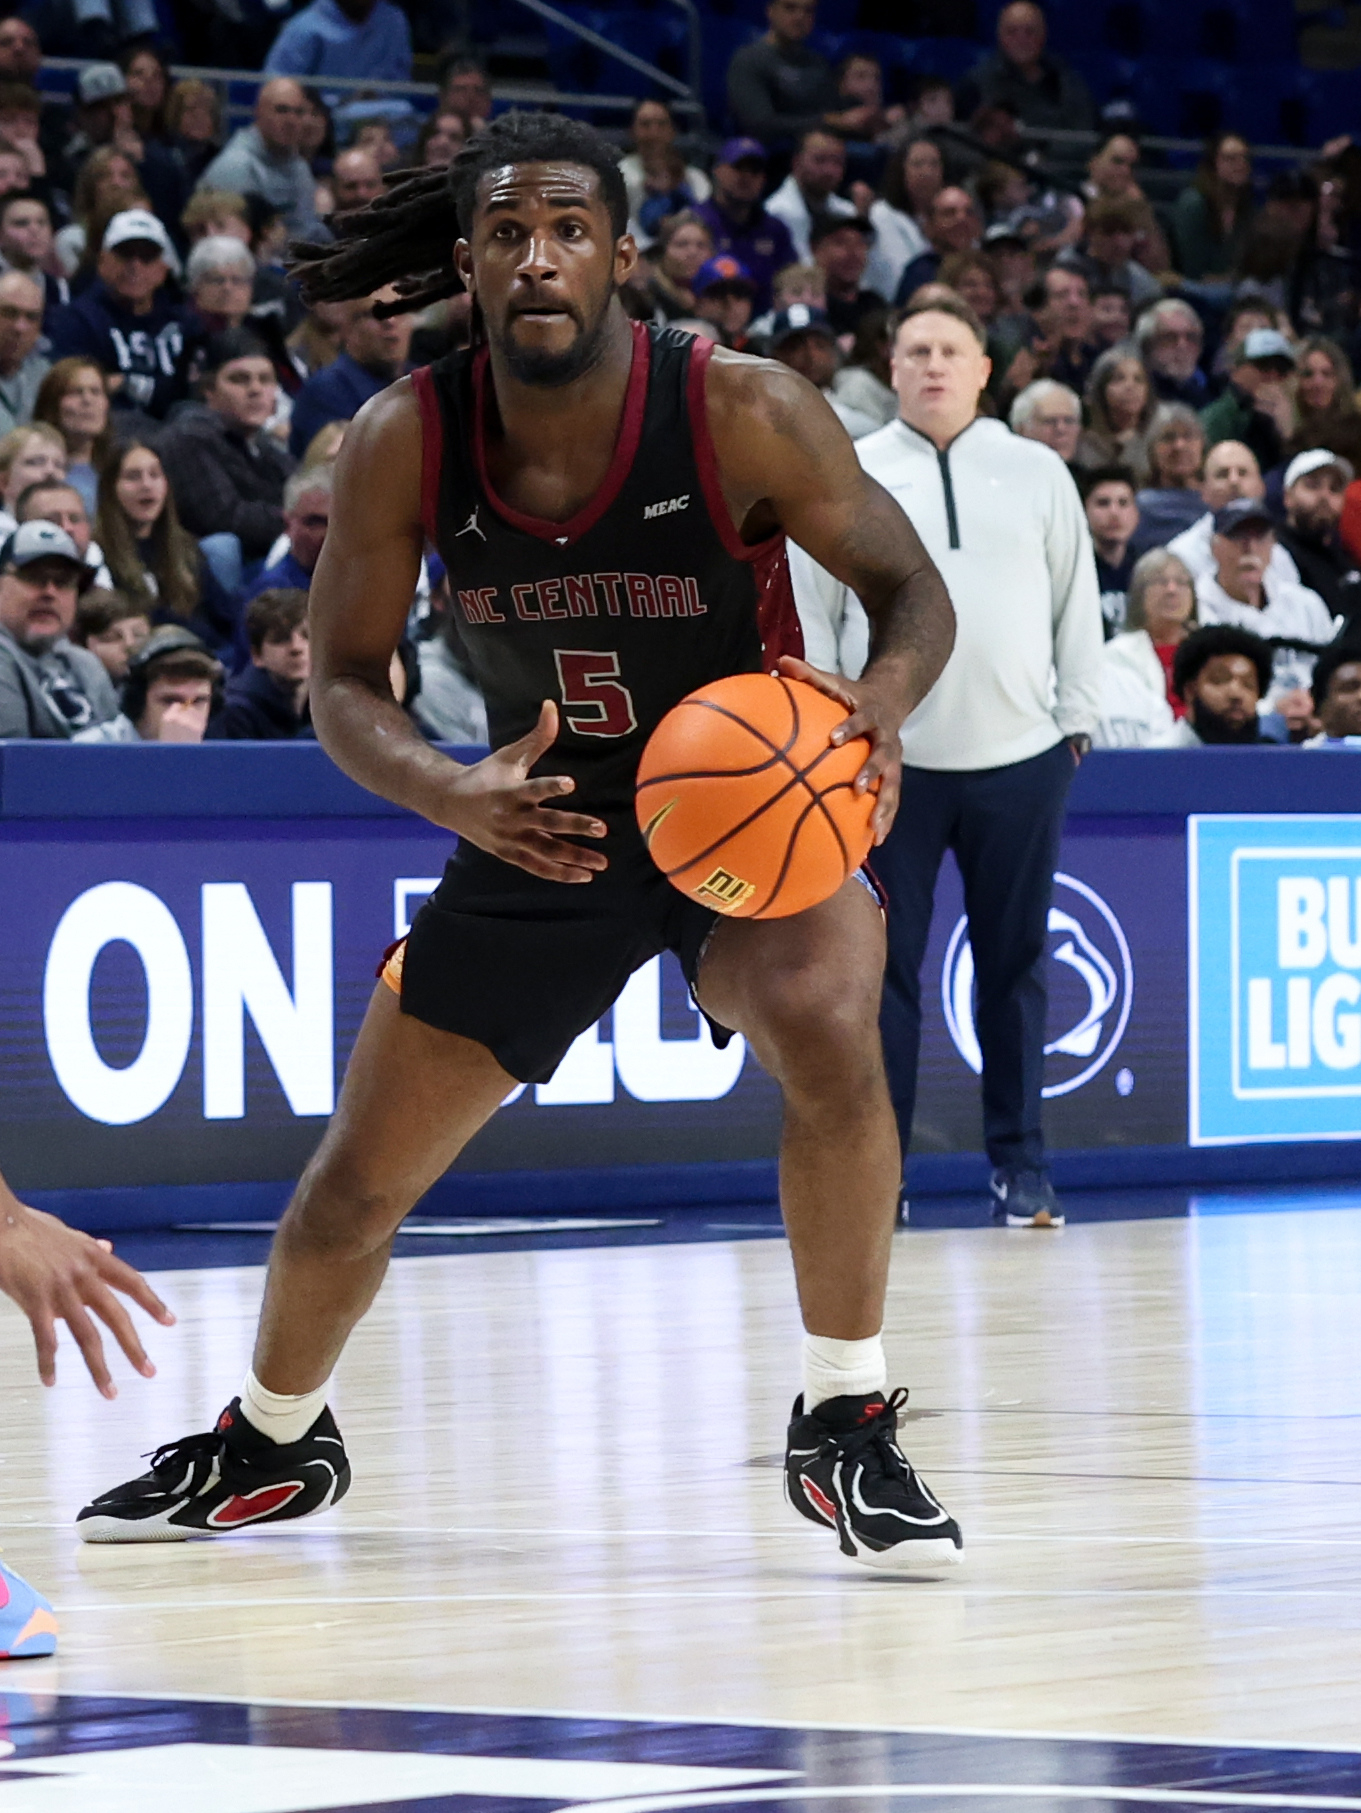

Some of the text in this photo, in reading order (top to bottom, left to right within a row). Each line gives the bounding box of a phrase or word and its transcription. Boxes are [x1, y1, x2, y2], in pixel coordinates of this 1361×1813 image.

[643, 494, 690, 520] MEAC
[457, 572, 707, 624] NC CENTRAL
[553, 648, 638, 738] 5
[42, 880, 336, 1126] ON
